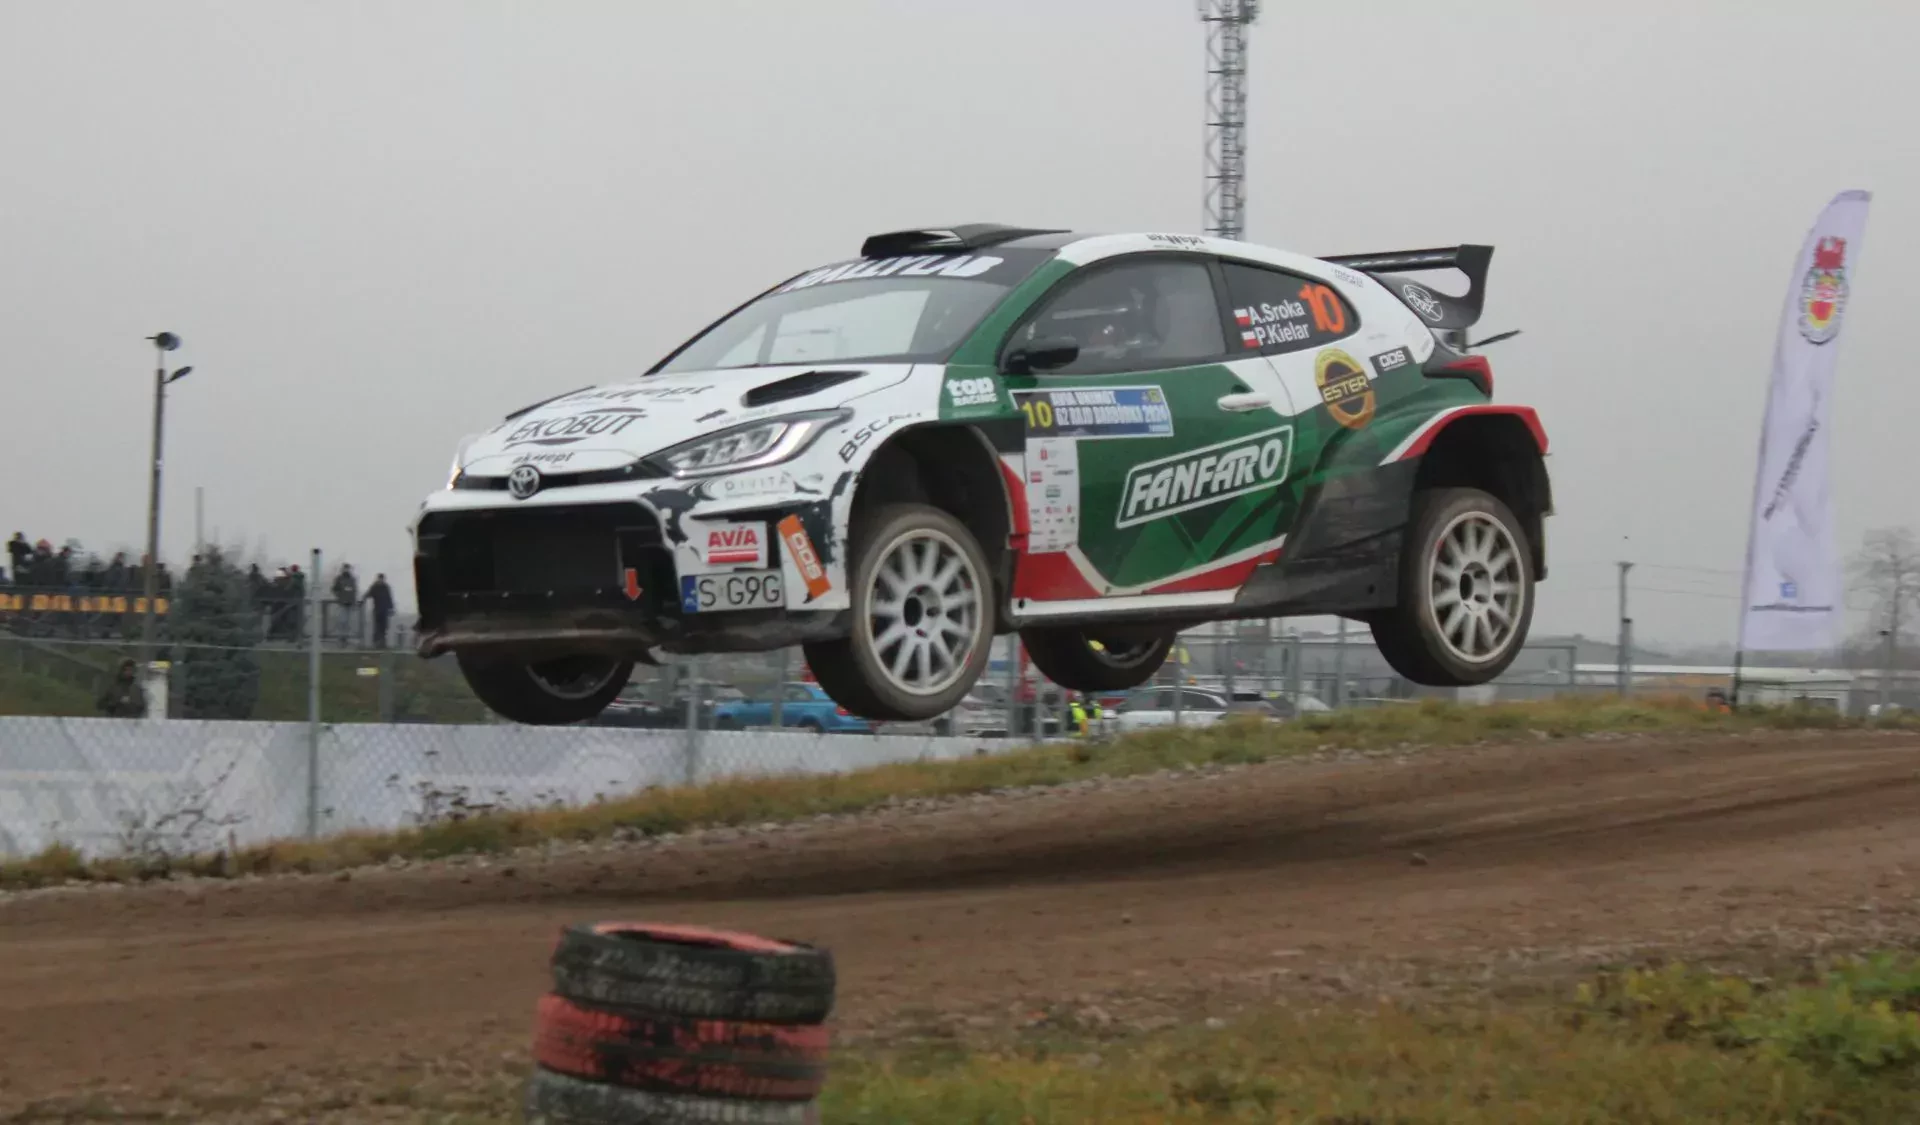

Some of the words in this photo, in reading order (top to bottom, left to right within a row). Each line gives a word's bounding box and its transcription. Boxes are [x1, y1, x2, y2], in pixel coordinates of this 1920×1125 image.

[1249, 299, 1306, 325] A.Sroka
[1297, 281, 1345, 334] 10
[1257, 322, 1310, 346] P.Kielar
[1323, 375, 1369, 402] ESTER
[1022, 400, 1053, 427] 10
[505, 414, 648, 442] EKOBUT
[1126, 438, 1283, 518] FANFARO
[699, 579, 717, 608] S
[726, 575, 780, 606] G9G
